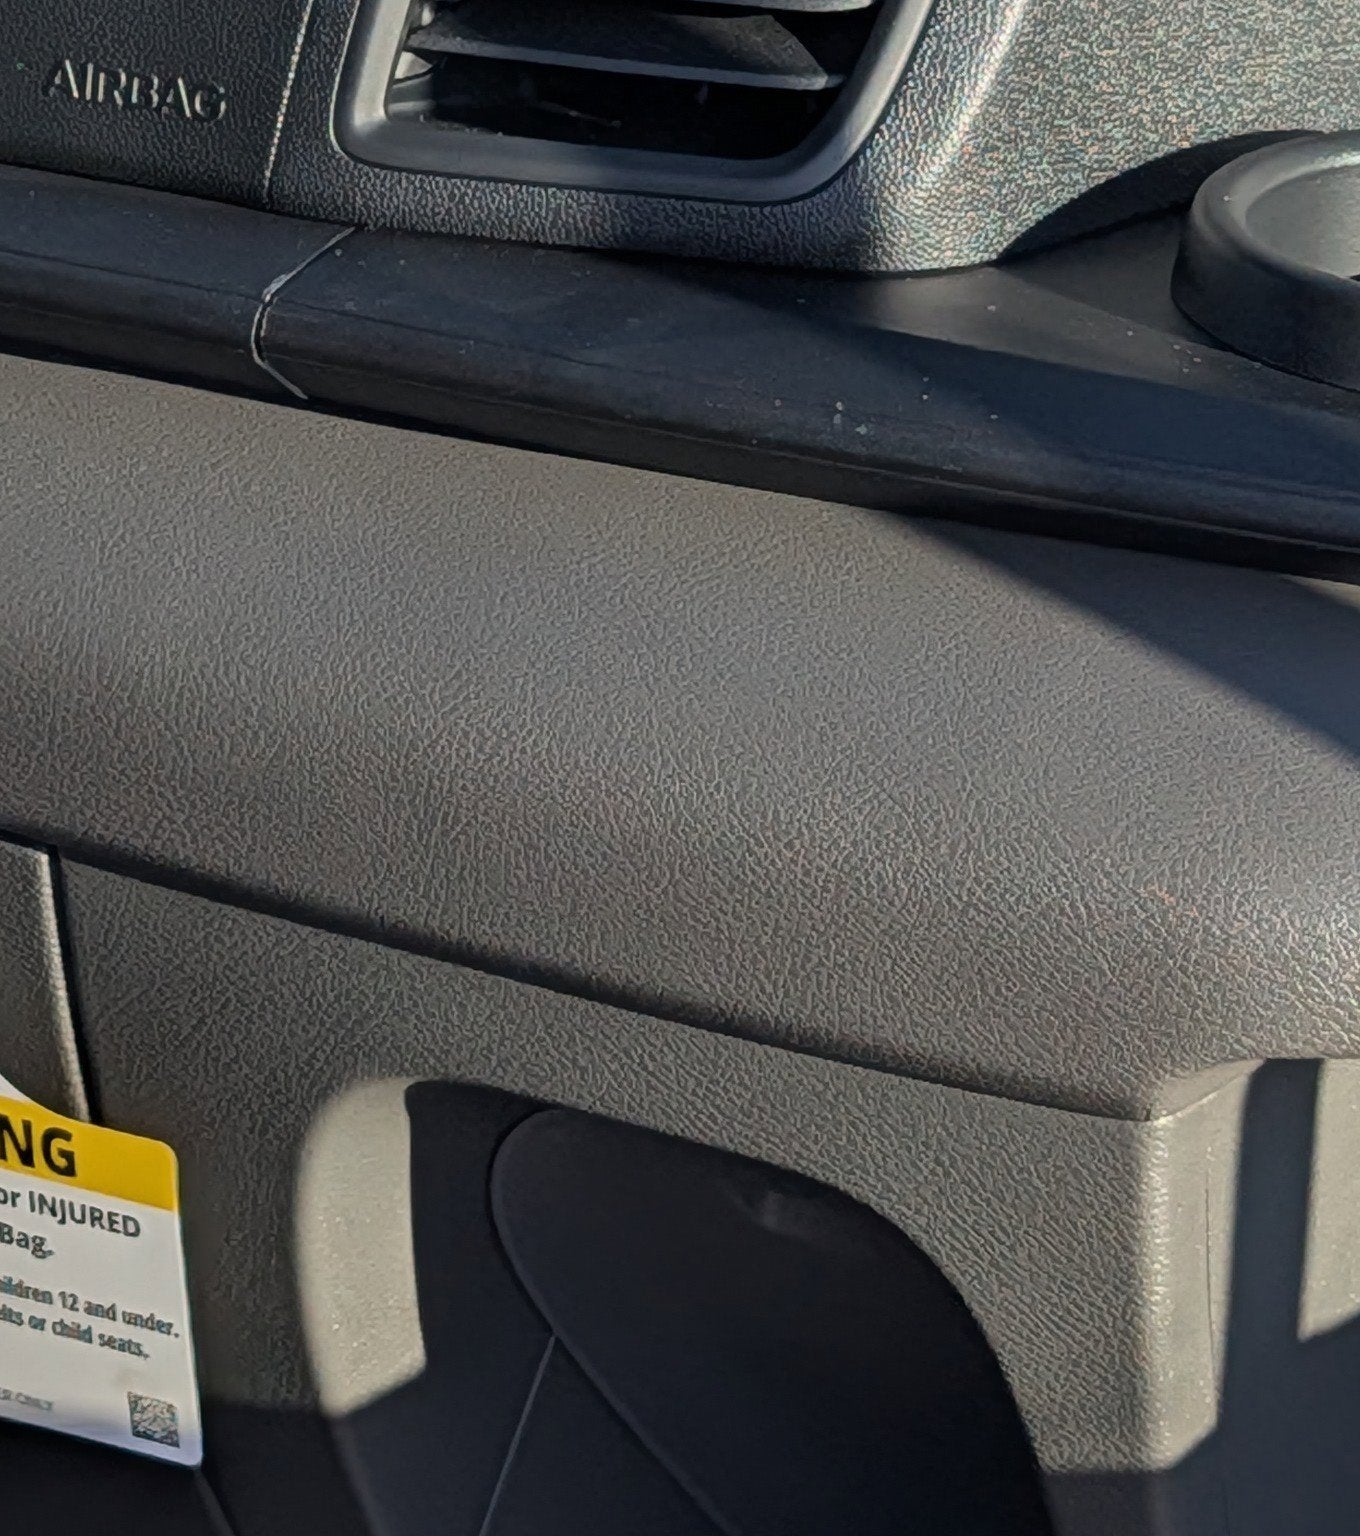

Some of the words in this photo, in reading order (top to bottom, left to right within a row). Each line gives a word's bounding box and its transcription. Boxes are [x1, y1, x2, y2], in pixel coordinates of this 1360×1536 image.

[43, 59, 227, 121] AIRBAG
[28, 1190, 141, 1238] INJURED
[58, 1290, 80, 1312] 12
[83, 1300, 117, 1322] and
